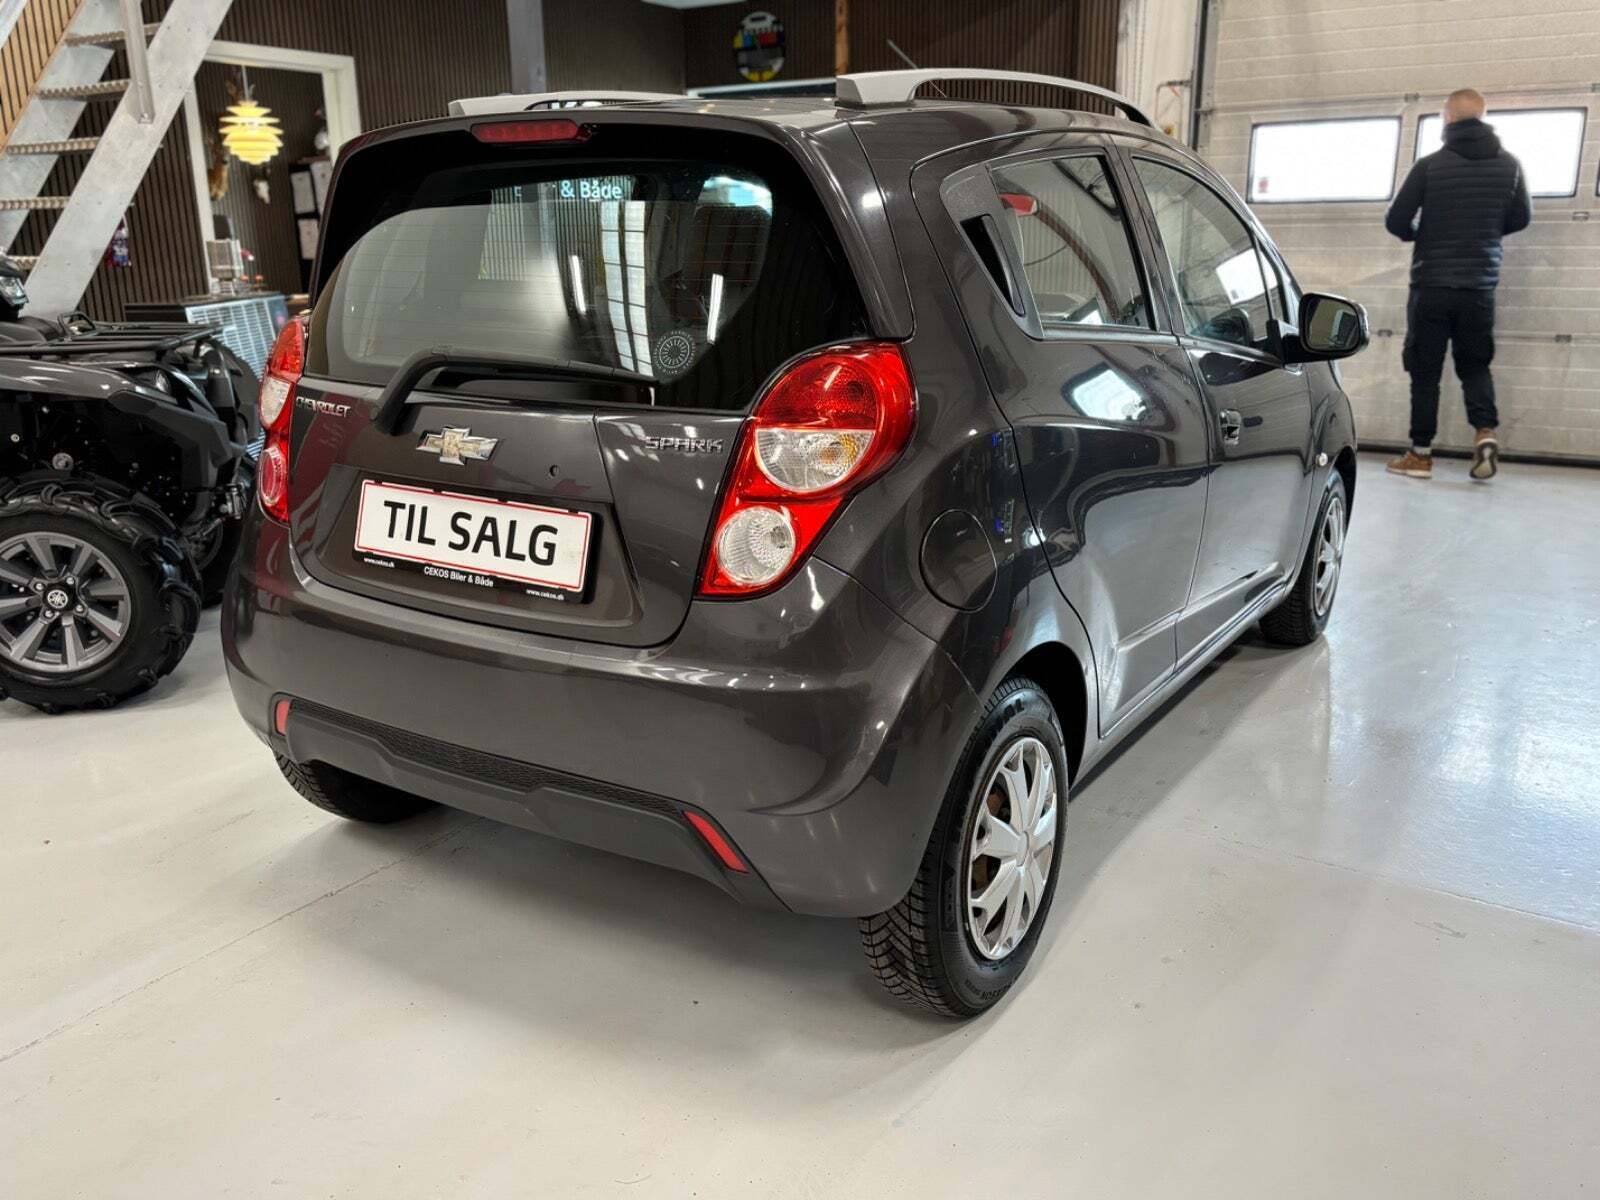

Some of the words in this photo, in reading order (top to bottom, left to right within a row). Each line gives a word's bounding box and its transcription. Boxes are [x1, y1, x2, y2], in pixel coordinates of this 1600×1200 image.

[560, 180, 575, 198] &
[580, 179, 623, 199] Både
[295, 396, 351, 418] CHEVROLET
[644, 436, 723, 453] SPARK
[384, 501, 436, 546] TIL
[448, 512, 558, 566] SALG
[423, 566, 450, 579] CEKOS
[450, 570, 467, 582] Biler
[467, 574, 474, 584] &
[475, 576, 494, 588] Både
